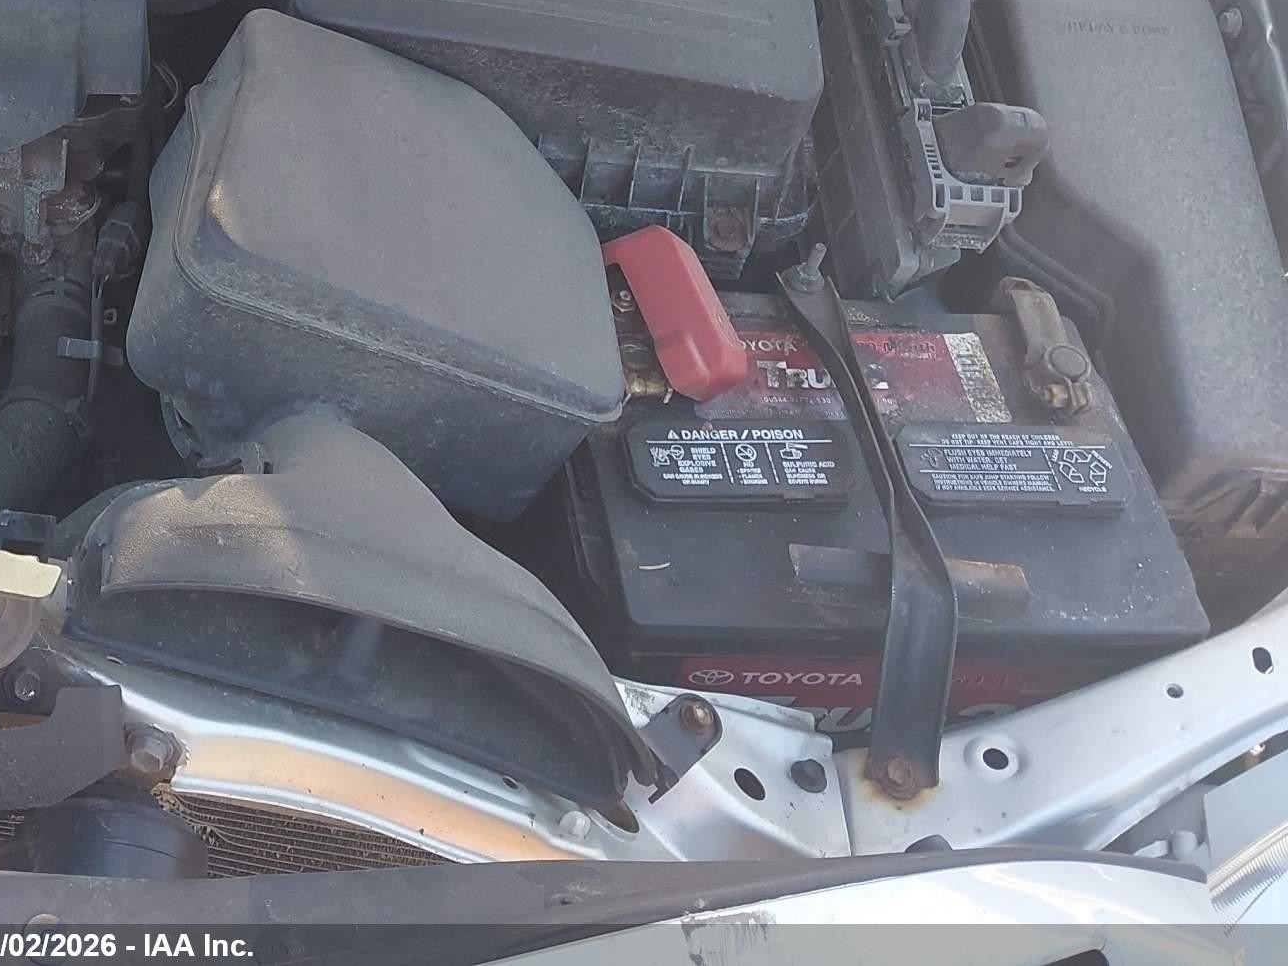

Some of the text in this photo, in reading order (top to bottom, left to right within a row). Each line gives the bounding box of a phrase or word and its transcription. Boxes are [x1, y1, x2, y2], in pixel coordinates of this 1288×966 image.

[681, 429, 737, 440] DANGER
[752, 429, 804, 440] POISON
[943, 449, 1033, 457] FLUSH EYES IMMEDIATELY
[946, 456, 966, 464] WITH
[949, 463, 1018, 471] MEDICAL HELP FAST
[741, 671, 863, 686] TOYOTA
